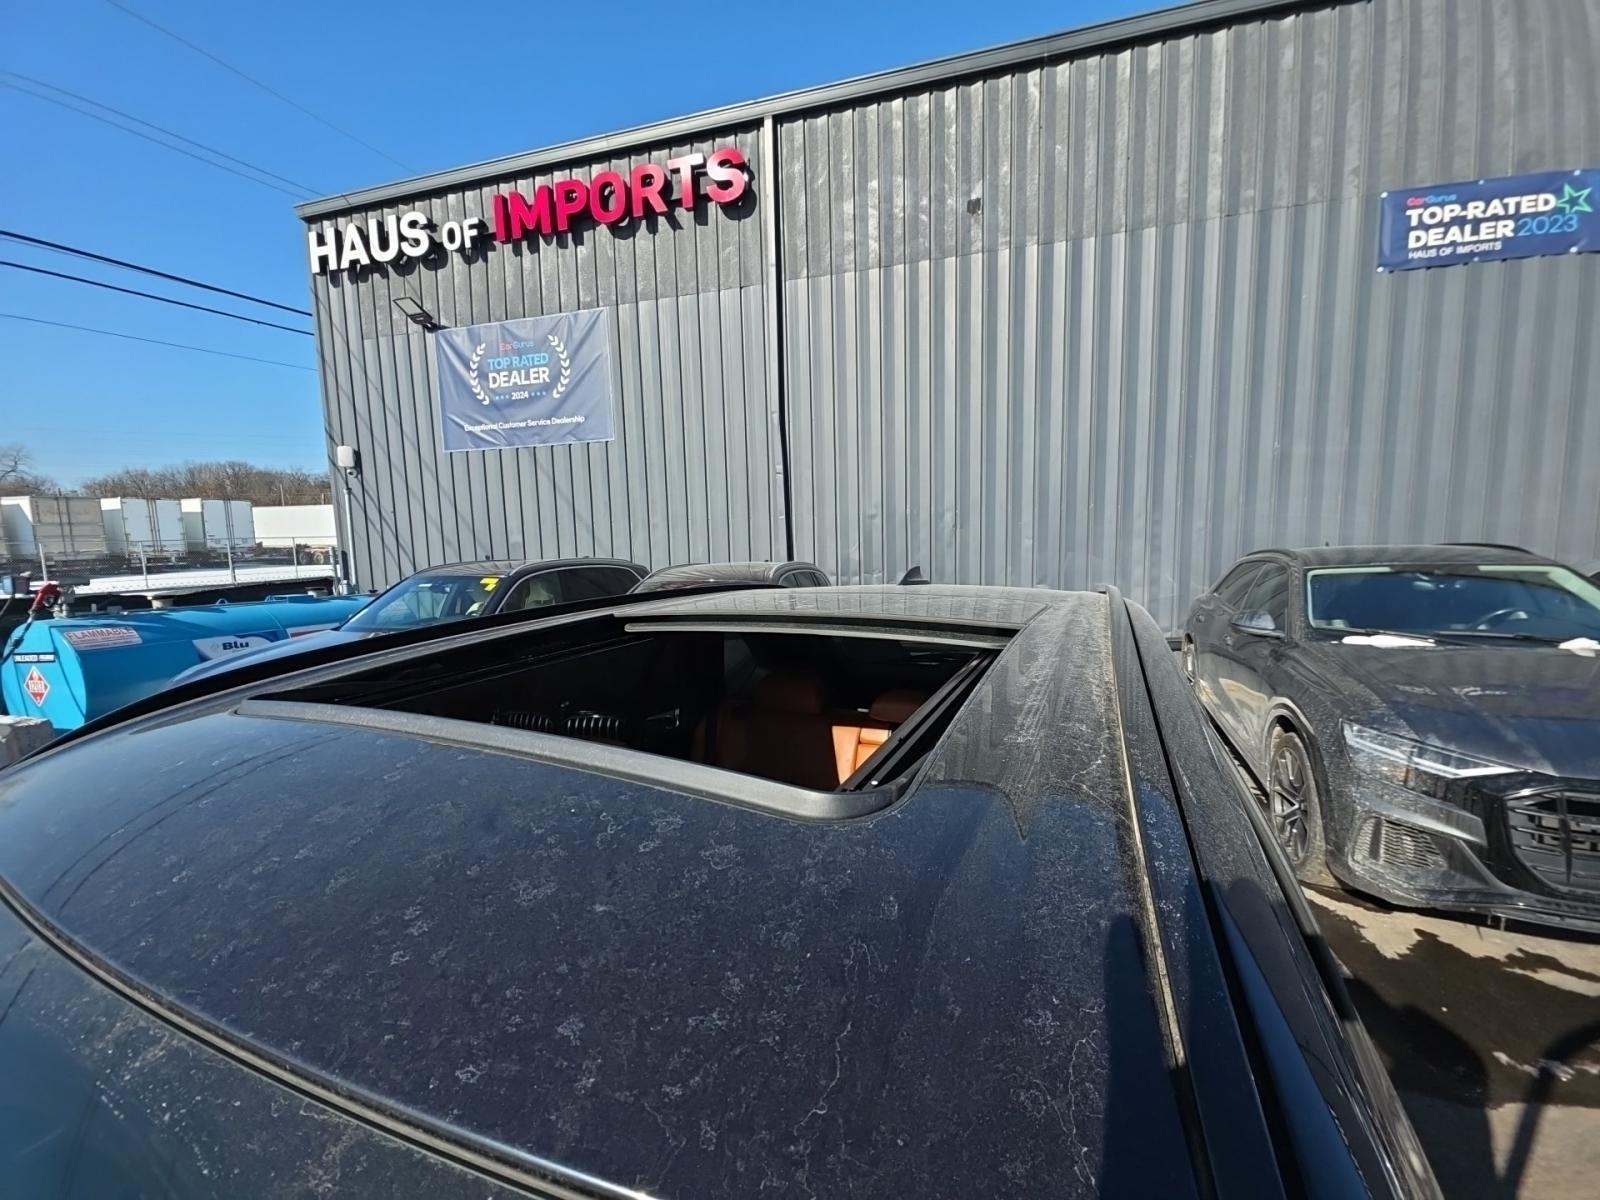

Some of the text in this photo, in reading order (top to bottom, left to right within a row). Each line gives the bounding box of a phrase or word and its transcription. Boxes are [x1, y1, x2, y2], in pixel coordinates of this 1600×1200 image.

[308, 148, 750, 274] HAUS OF IMPORTS
[1405, 193, 1557, 227] TOP-RATED
[1408, 214, 1579, 249] DEALER 2023
[1408, 241, 1502, 259] HAUS OF IMPORTS
[488, 353, 549, 370] TOP RATED
[489, 367, 550, 388] DEALER
[511, 391, 529, 400] 2024
[498, 420, 526, 429] Customer
[527, 419, 551, 427] Service
[551, 415, 585, 425] Dealership
